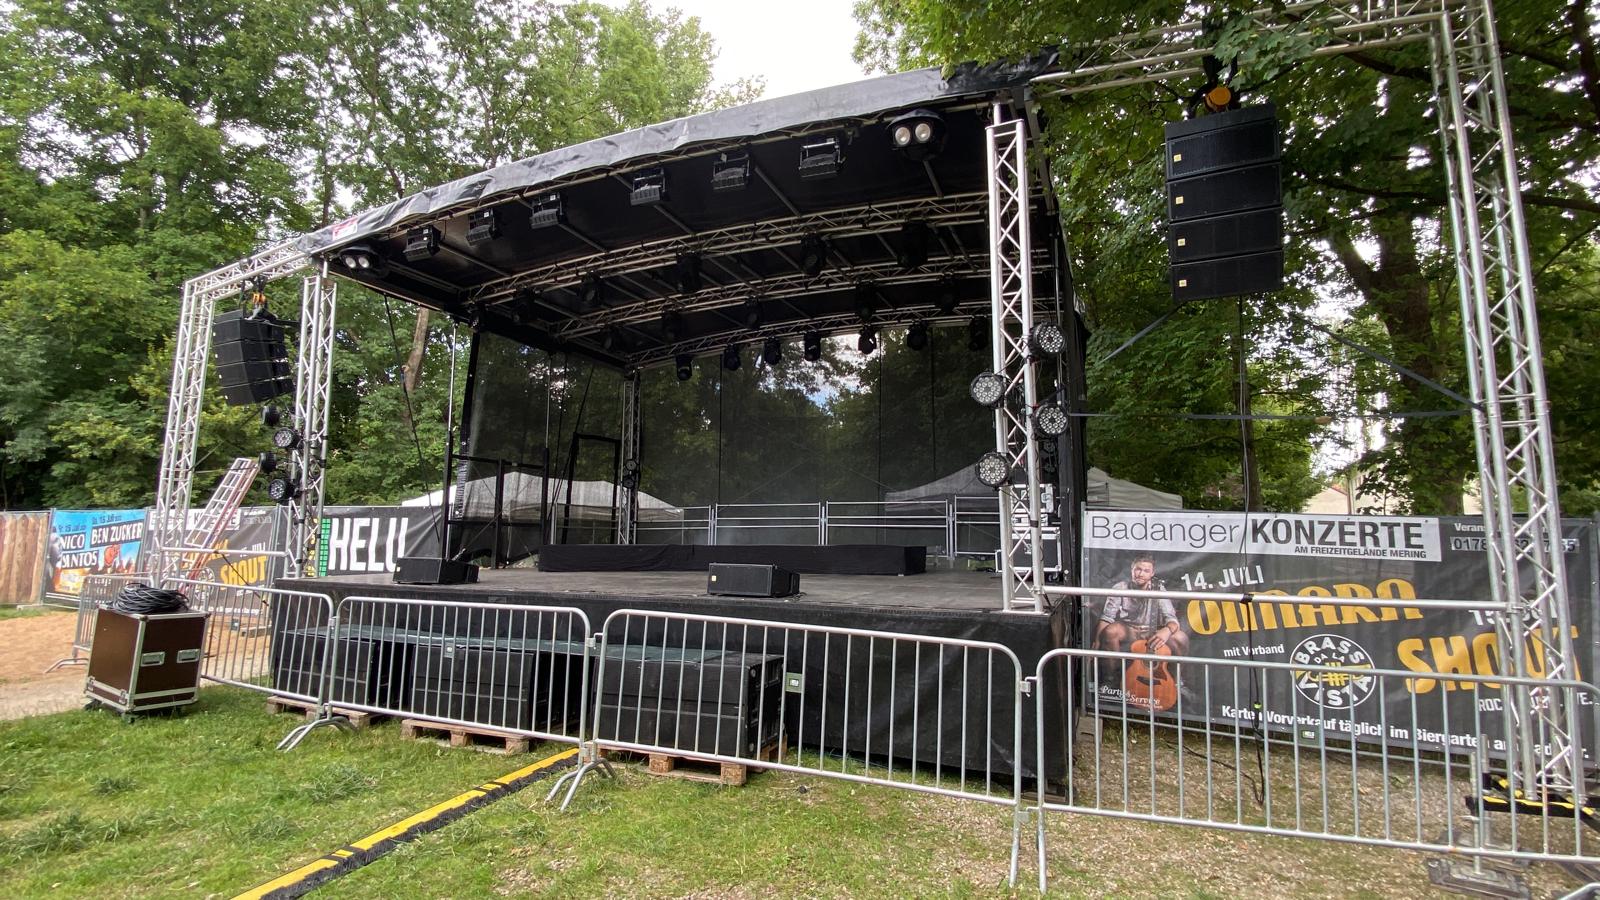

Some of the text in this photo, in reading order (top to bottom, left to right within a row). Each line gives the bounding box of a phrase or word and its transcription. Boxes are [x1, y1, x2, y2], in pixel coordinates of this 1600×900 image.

[60, 533, 85, 550] NICO
[91, 522, 143, 545] BEN ZUCKER
[1091, 515, 1424, 549] Badanger KONZERTE
[1294, 545, 1308, 554] AM
[1389, 549, 1427, 559] MERING
[220, 555, 267, 591] SHOUT
[1180, 565, 1265, 592] 14. JULI
[1223, 643, 1285, 657] mit Vorband
[1295, 636, 1365, 665] BRASS
[1298, 672, 1372, 706] VISTA
[1390, 725, 1409, 739] im
[1415, 728, 1490, 750] Biergarte
